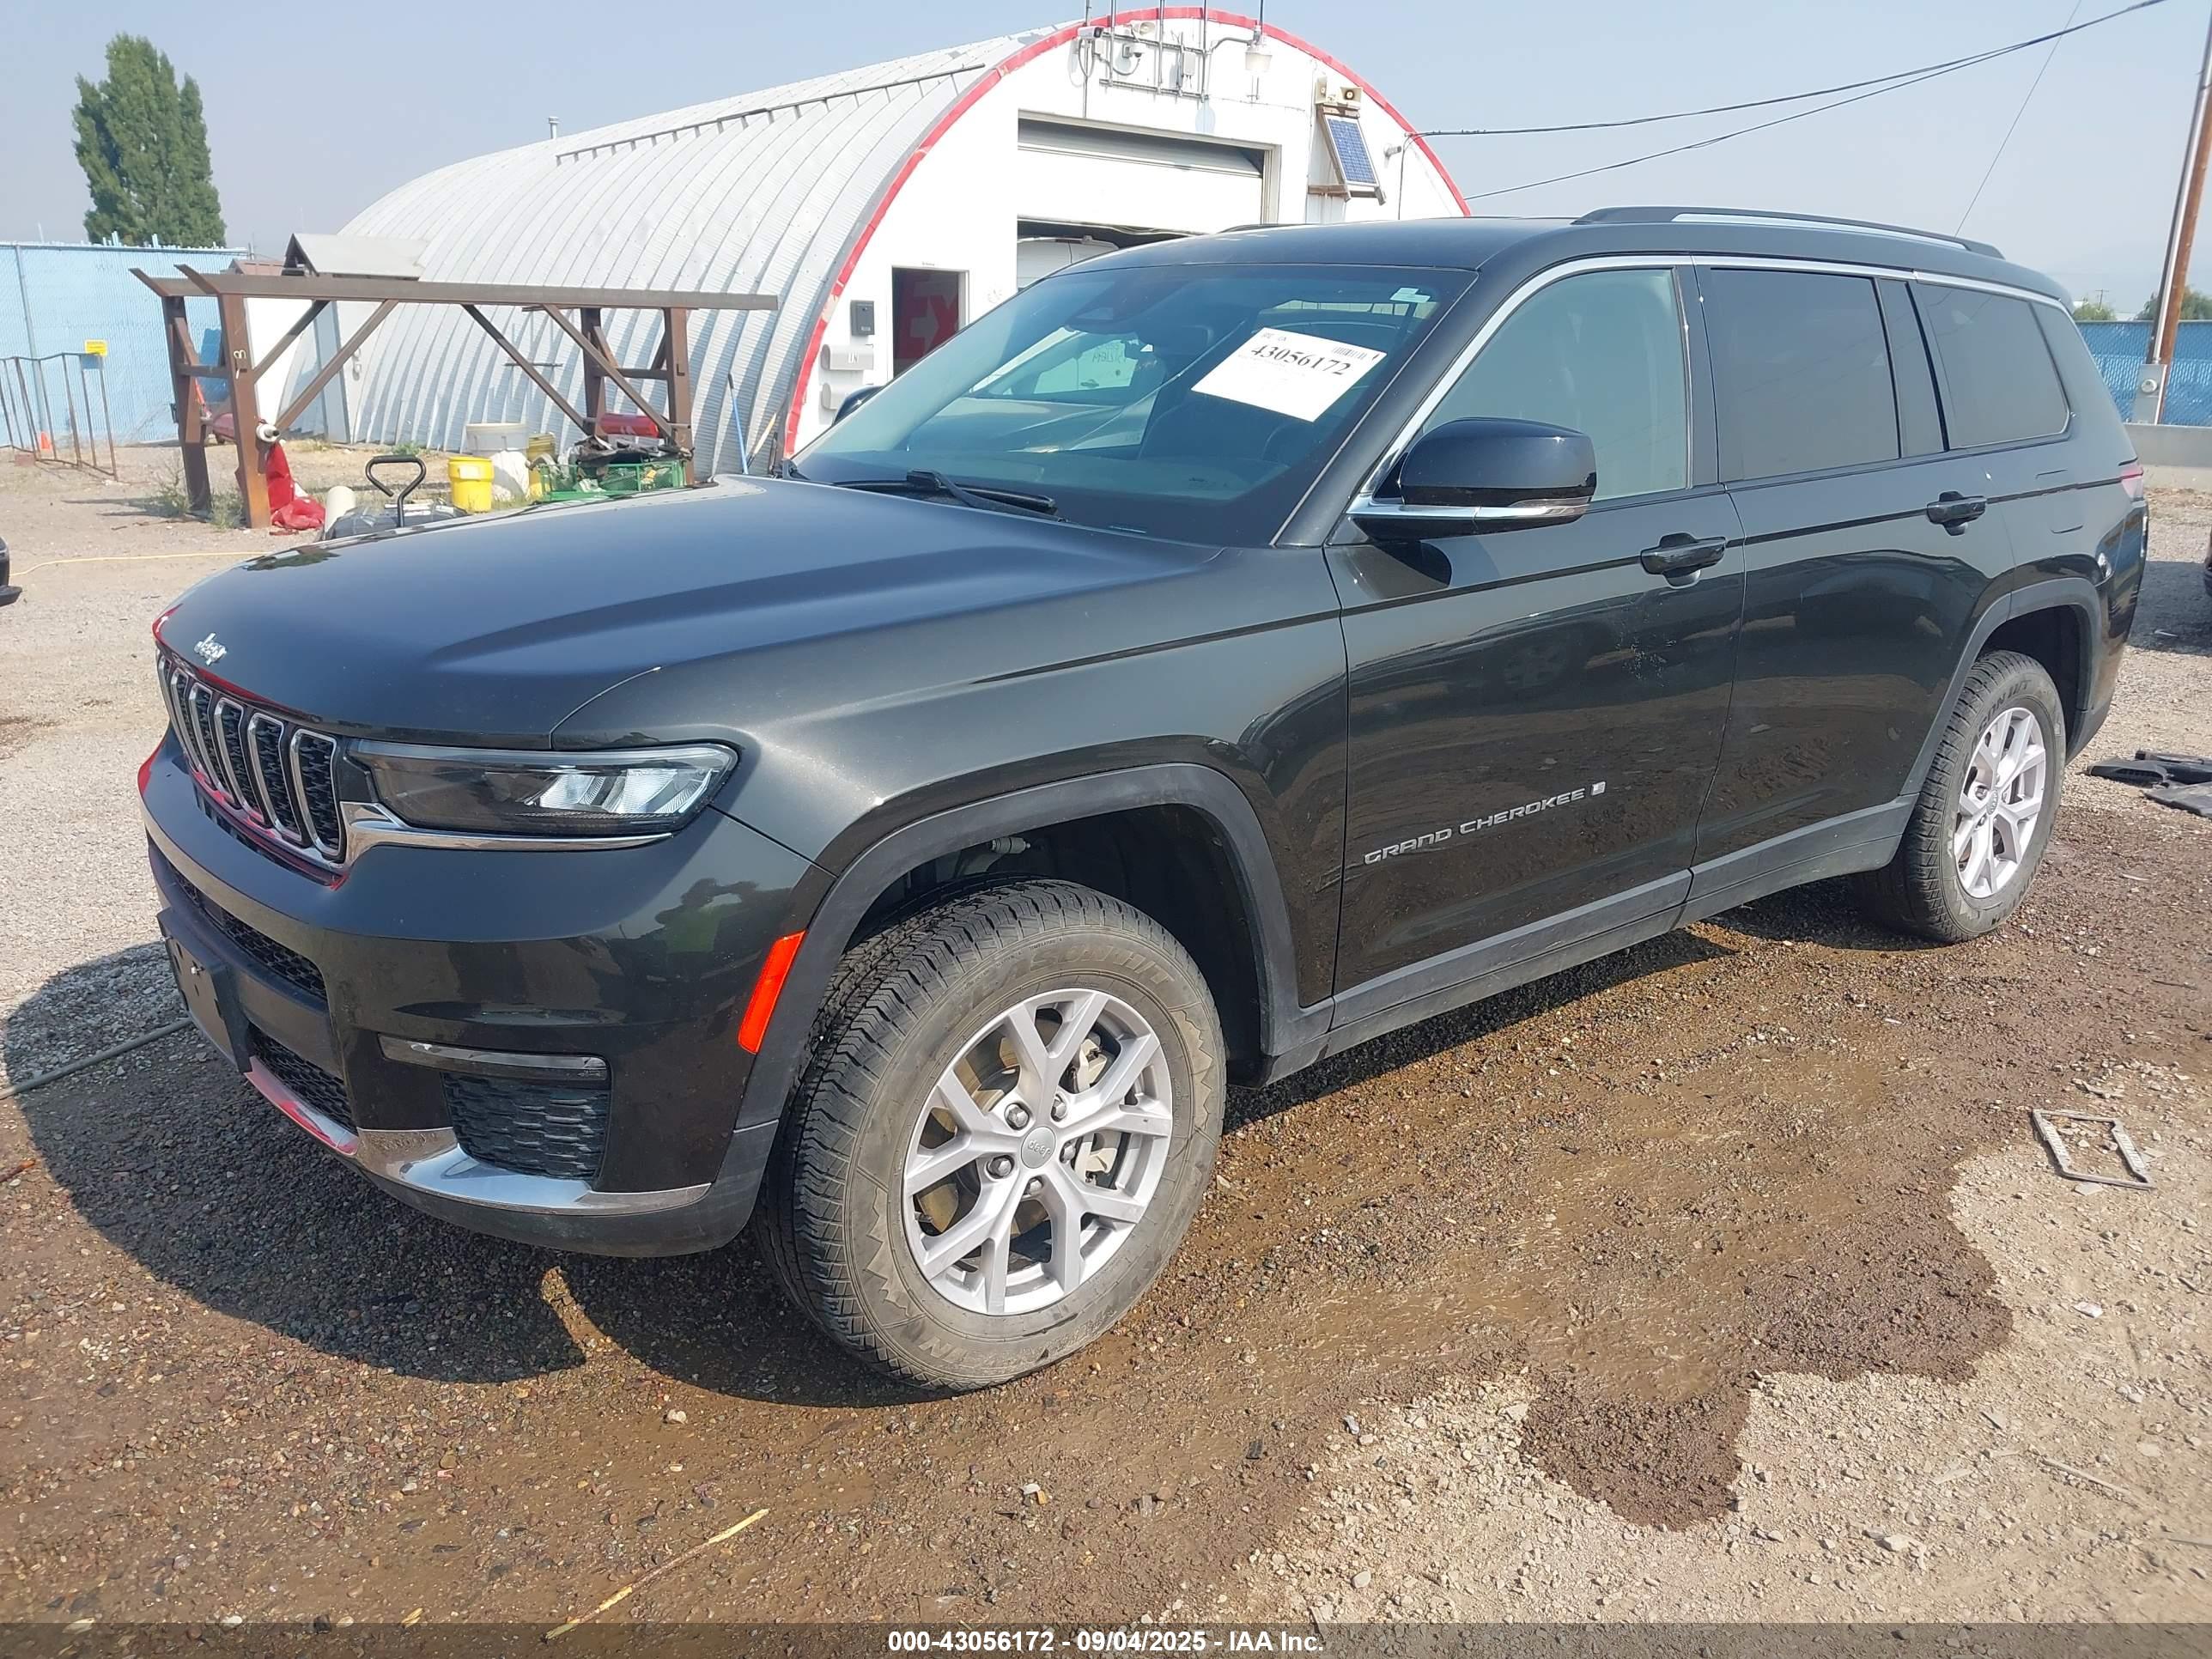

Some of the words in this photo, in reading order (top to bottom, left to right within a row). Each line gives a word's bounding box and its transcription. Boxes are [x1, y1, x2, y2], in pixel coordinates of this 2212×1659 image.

[1251, 344, 1351, 375] 43056172
[194, 632, 227, 665] Jeep
[1364, 828, 1452, 865] GRAND
[1460, 788, 1585, 835] CHEROKEE
